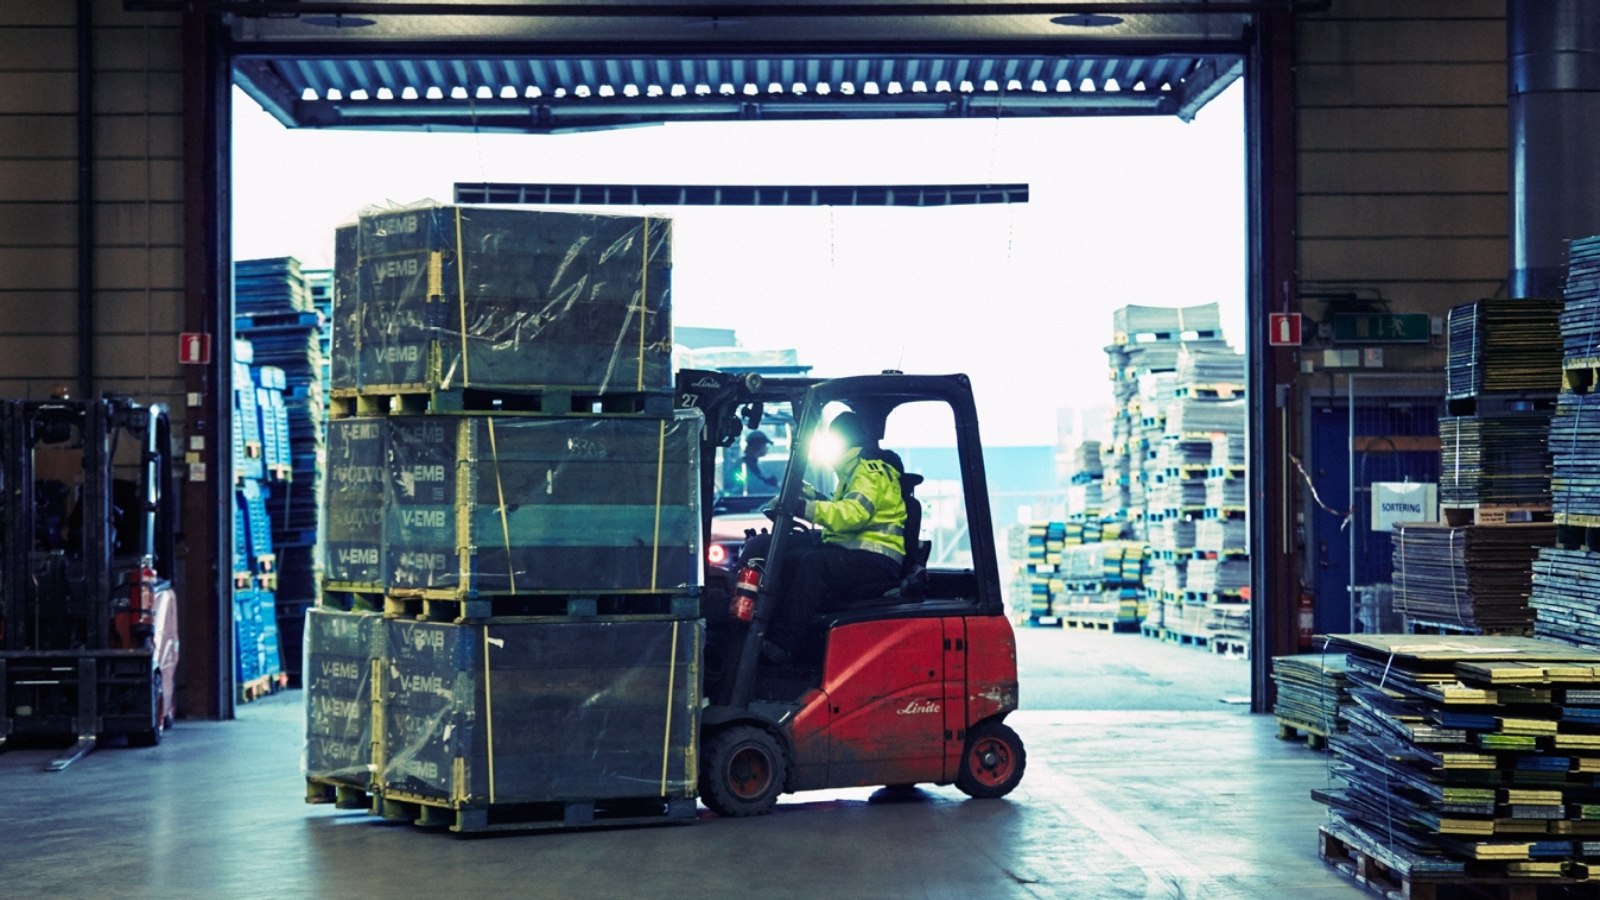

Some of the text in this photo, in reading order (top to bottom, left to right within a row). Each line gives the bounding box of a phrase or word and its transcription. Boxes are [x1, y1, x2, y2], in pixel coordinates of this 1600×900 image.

[374, 345, 418, 363] V-EMB
[691, 376, 720, 389] Linde
[681, 393, 699, 408] 27
[400, 465, 445, 482] VEMB
[1382, 503, 1421, 513] SORTERING
[402, 510, 446, 527] V-EMB
[338, 548, 379, 565] V-EMB
[321, 660, 359, 679] V-EMB
[400, 674, 443, 692] V-EMB
[896, 698, 942, 715] Linde
